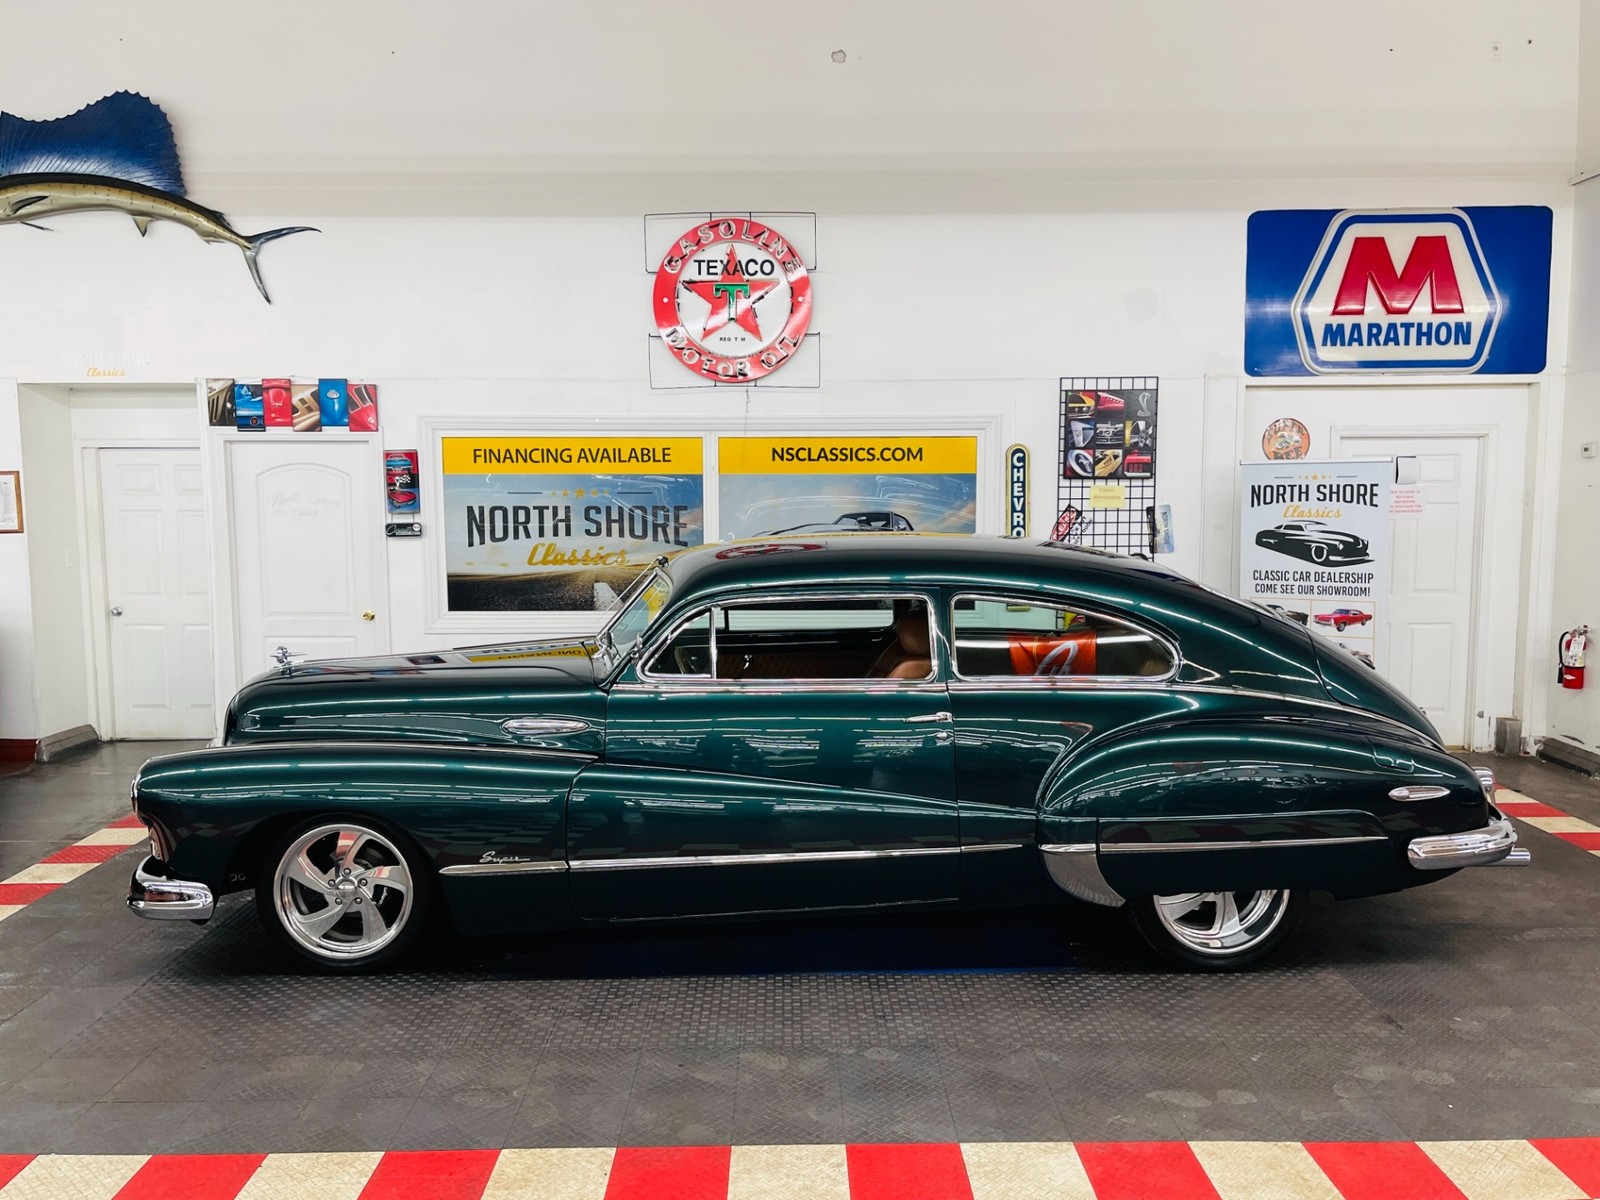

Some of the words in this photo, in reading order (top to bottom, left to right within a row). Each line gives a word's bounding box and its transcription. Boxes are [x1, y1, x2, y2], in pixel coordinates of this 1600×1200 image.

[664, 220, 802, 275] GASOLINE
[693, 259, 775, 277] TEXACO
[1329, 235, 1465, 316] M
[713, 283, 750, 322] T
[1321, 321, 1472, 347] MARATHON
[665, 327, 751, 379] MOTOR
[760, 334, 801, 370] OIL
[86, 367, 126, 377] Classics
[472, 448, 573, 464] FINANCING
[576, 447, 672, 463] AVAILABLE
[771, 446, 923, 462] NSCLASSICS.COM
[1250, 484, 1310, 508] NORTH
[1316, 483, 1379, 508] SHORE
[1283, 504, 1342, 518] Classics
[466, 505, 572, 547] NORTH
[584, 505, 689, 547] SHORE
[527, 543, 630, 566] Classics
[1253, 570, 1290, 581] CLASSIC
[1292, 571, 1311, 582] CAR
[1314, 572, 1374, 584] DEALERSHIP
[1255, 583, 1278, 593] COME
[1280, 584, 1295, 594] SEE
[1297, 585, 1315, 595] OUR
[1316, 585, 1371, 597] SHOWROOM!
[479, 850, 531, 864] Super
